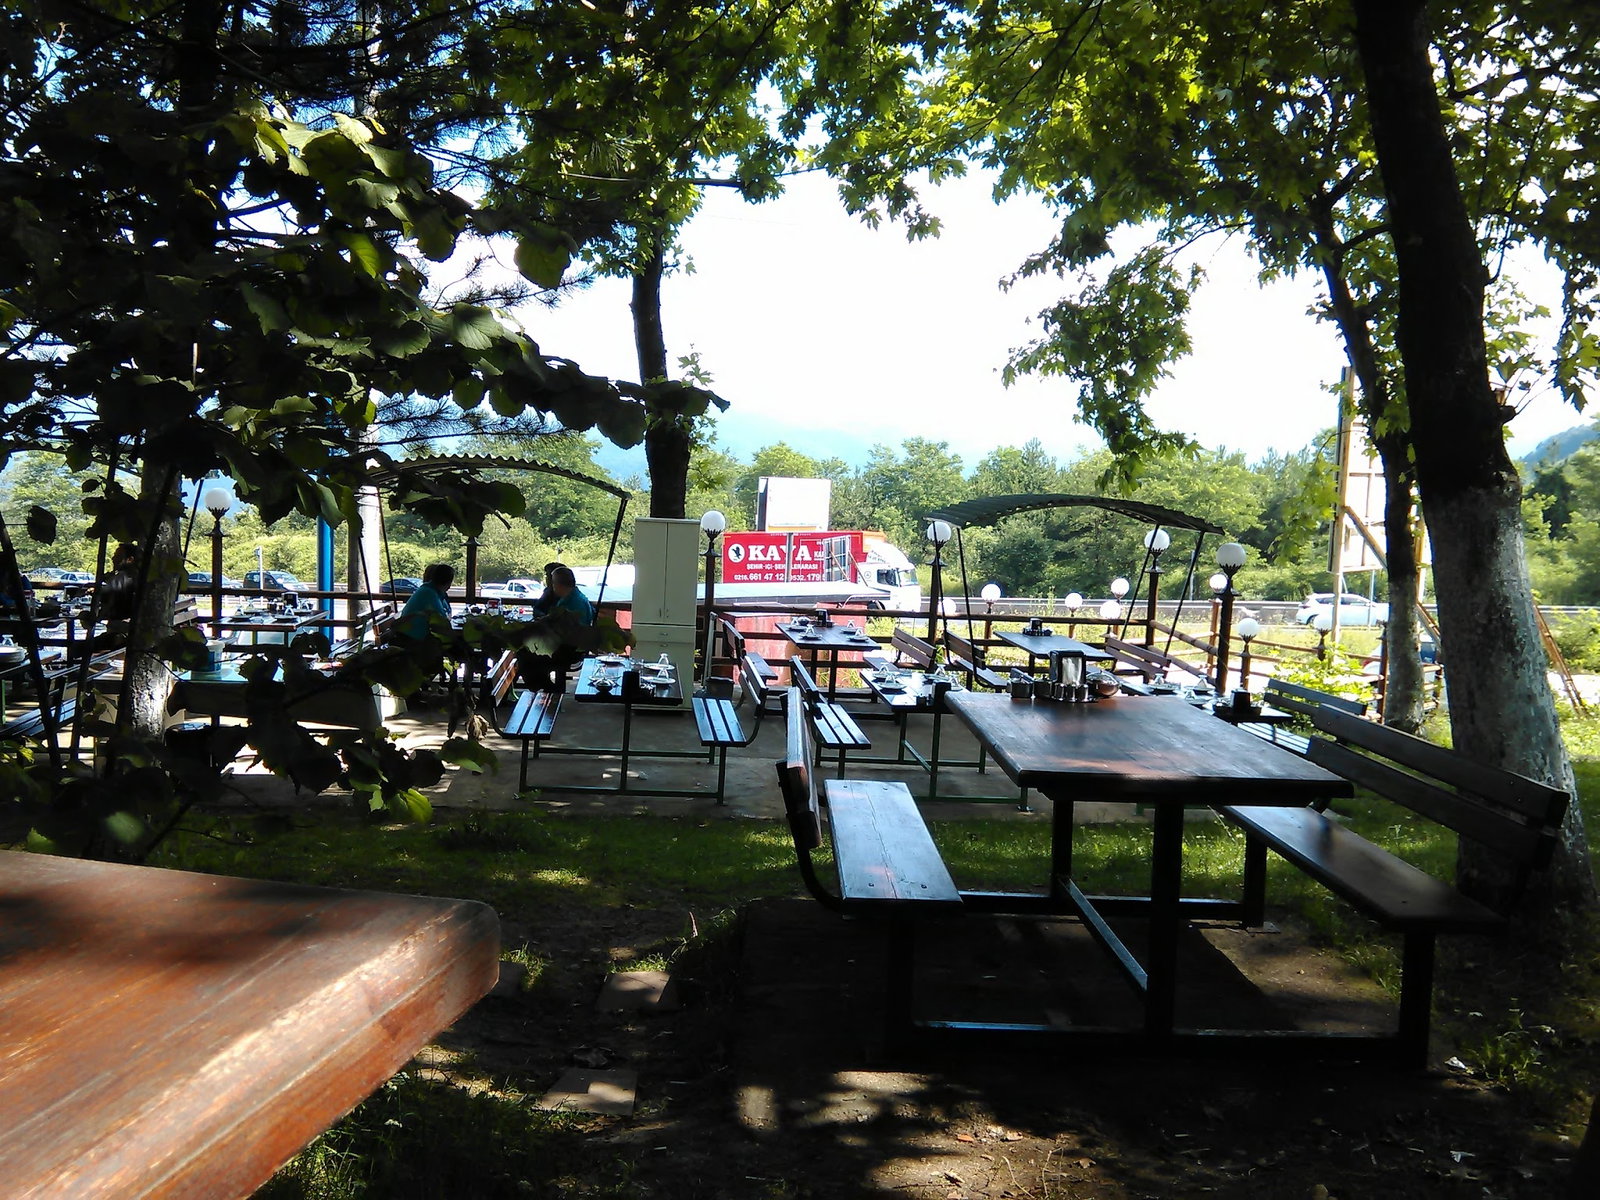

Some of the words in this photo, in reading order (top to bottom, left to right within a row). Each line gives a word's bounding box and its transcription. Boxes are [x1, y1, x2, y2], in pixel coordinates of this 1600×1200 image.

[748, 545, 812, 561] KAYA
[764, 573, 773, 581] 47
[775, 573, 785, 581] 12
